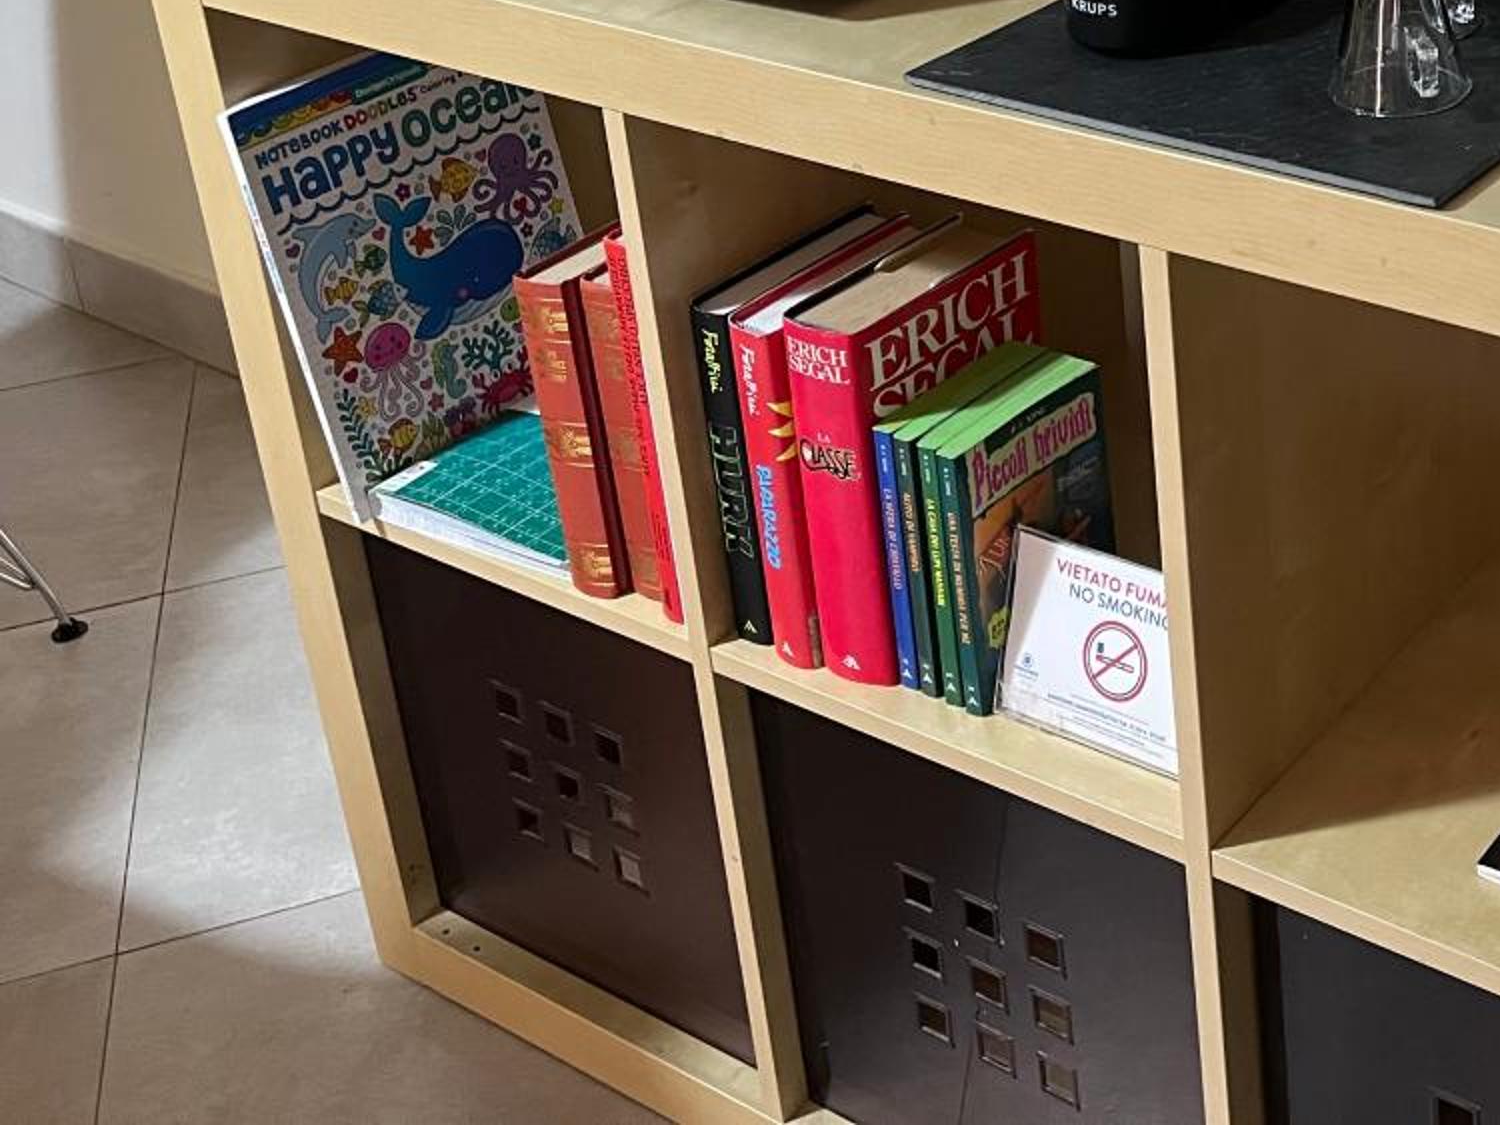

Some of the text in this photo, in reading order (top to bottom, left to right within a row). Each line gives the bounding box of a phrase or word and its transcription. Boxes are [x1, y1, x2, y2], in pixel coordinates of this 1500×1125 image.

[864, 251, 1031, 392] ERICH
[786, 335, 848, 368] ERICH
[788, 354, 851, 385] SEGAL
[817, 432, 831, 445] LA
[971, 435, 1029, 511] Piccoli
[1032, 397, 1095, 465] brividi
[800, 439, 862, 481] CLASSE
[1056, 558, 1122, 593] VIETATO
[1068, 583, 1094, 604] NO
